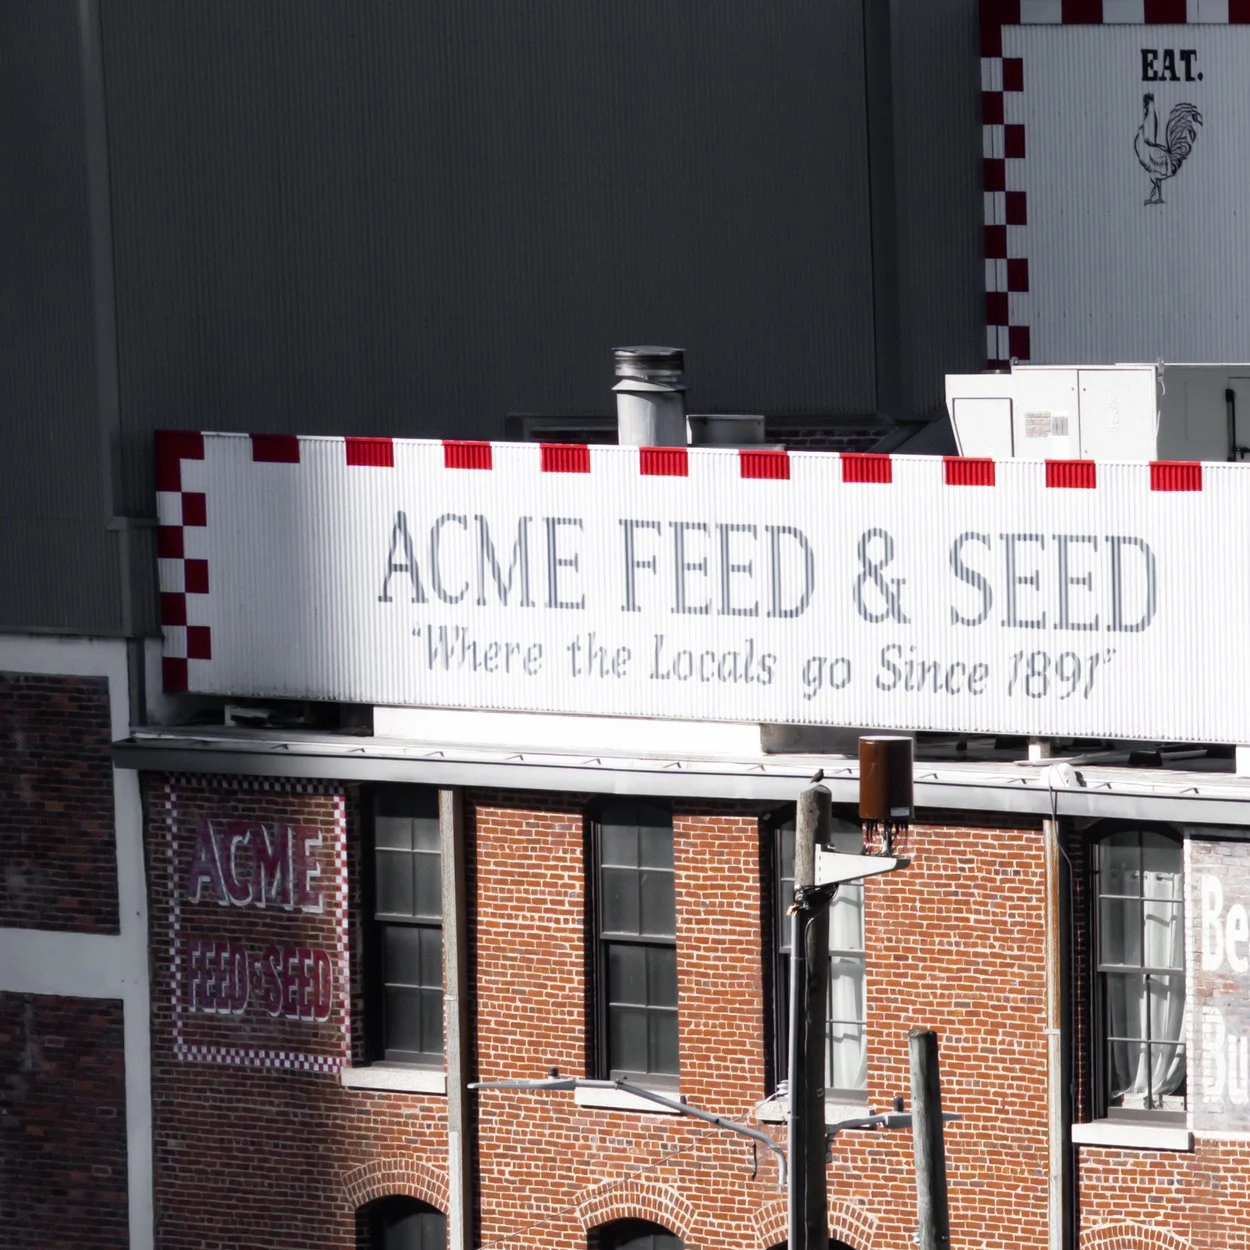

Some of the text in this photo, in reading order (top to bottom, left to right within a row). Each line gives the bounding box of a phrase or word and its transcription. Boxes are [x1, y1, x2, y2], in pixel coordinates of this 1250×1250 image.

[1140, 48, 1204, 82] EAT.
[377, 510, 1158, 634] ACME FEED & SEED
[566, 631, 629, 680] the
[649, 632, 778, 687] Locals
[801, 655, 852, 701] go
[875, 643, 990, 698] Since
[186, 818, 325, 914] ACME
[187, 939, 250, 1016] FEED
[265, 944, 335, 1023] SEED
